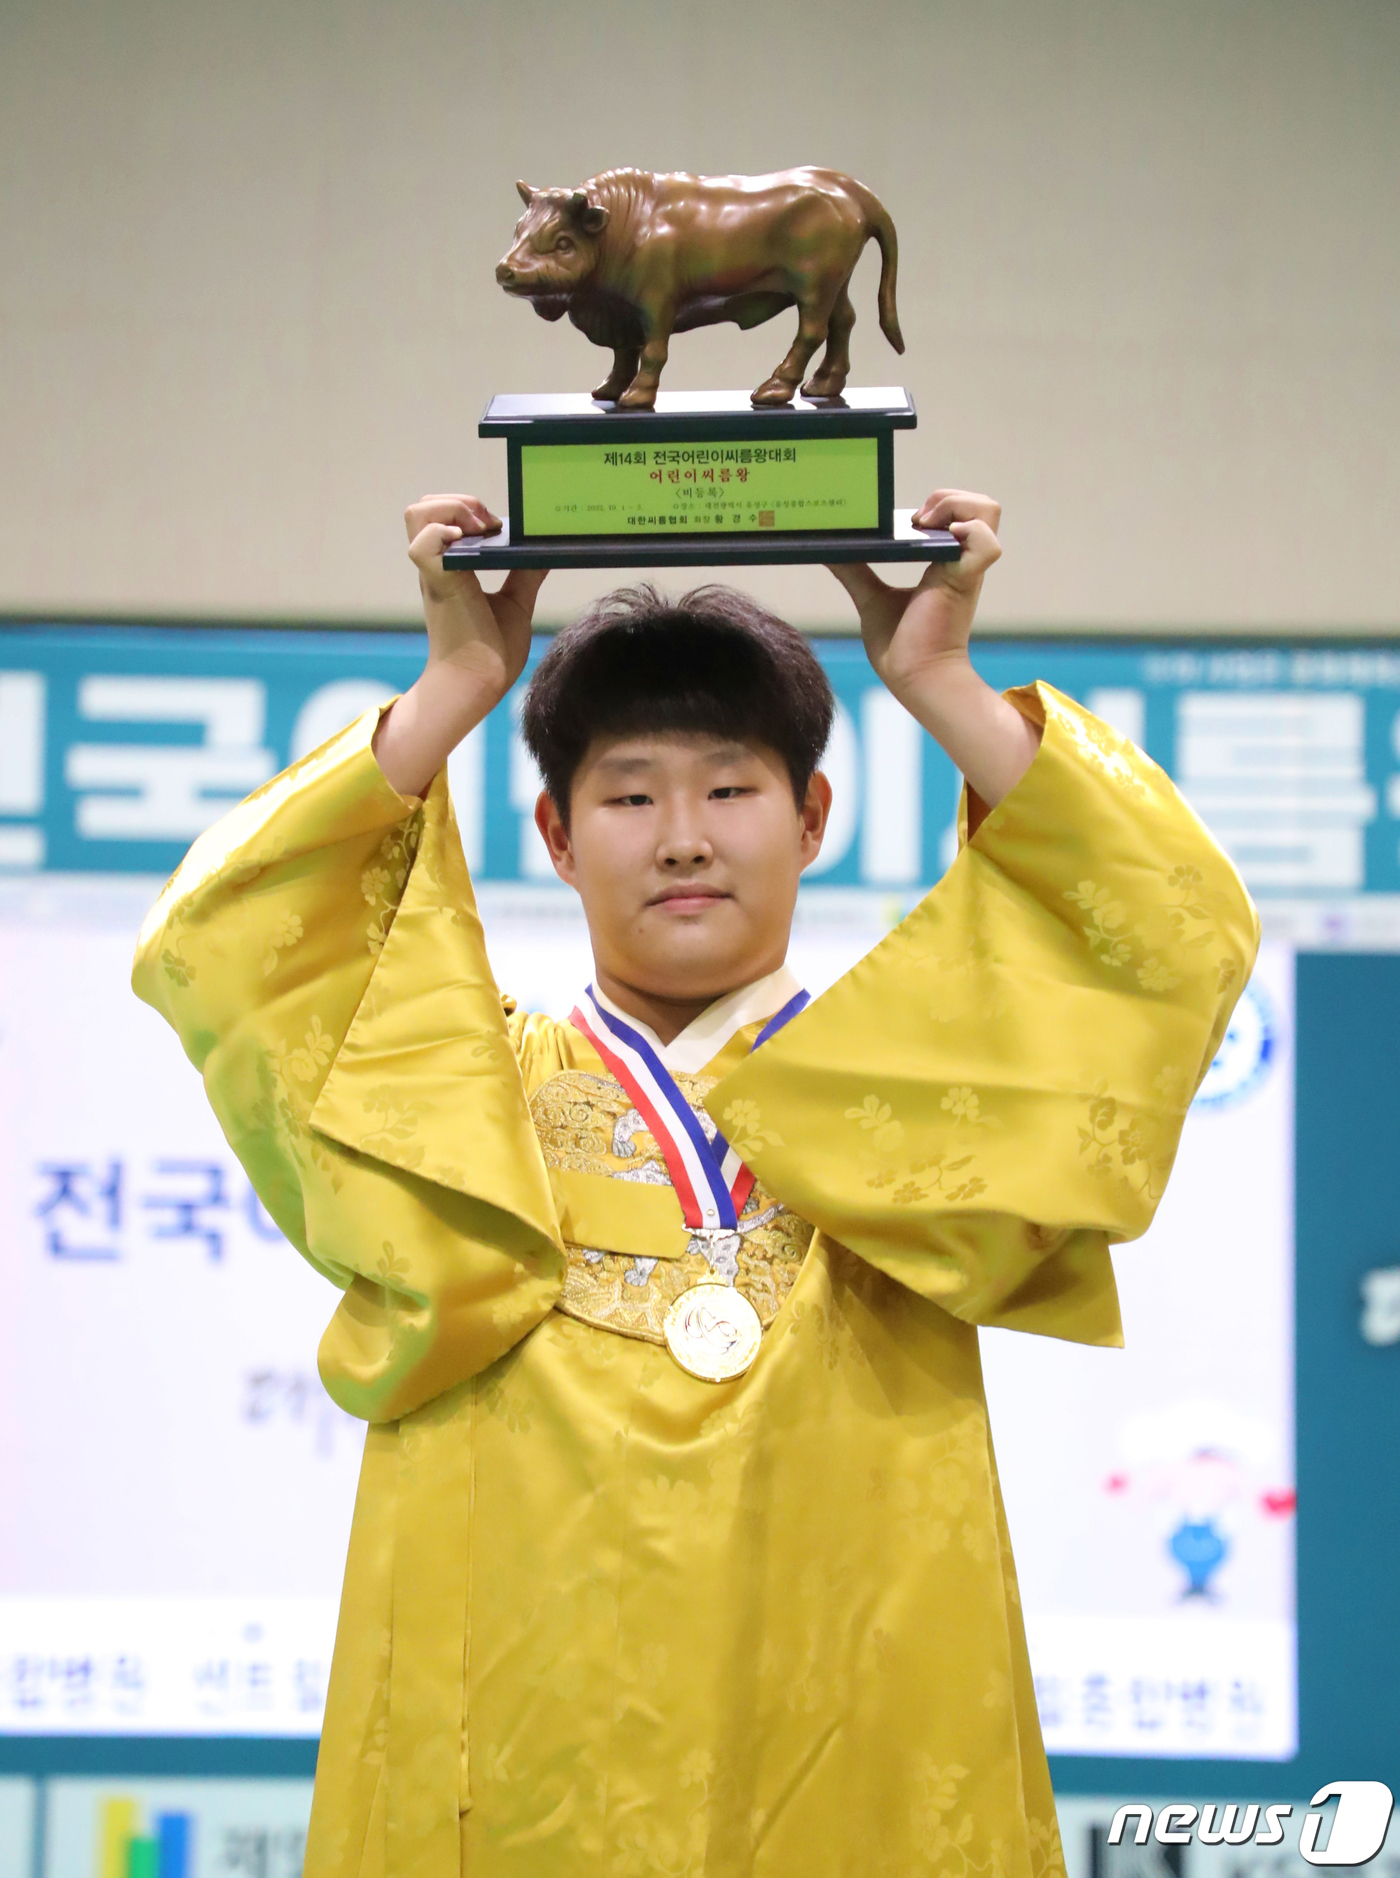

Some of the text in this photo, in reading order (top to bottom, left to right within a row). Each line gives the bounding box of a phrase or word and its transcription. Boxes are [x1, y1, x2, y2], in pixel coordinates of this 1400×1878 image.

[604, 447, 797, 466] 제14회 전국어린이씨름왕대회
[649, 467, 751, 484] 어린이씨름왕
[627, 515, 688, 525] 대한씨름협회
